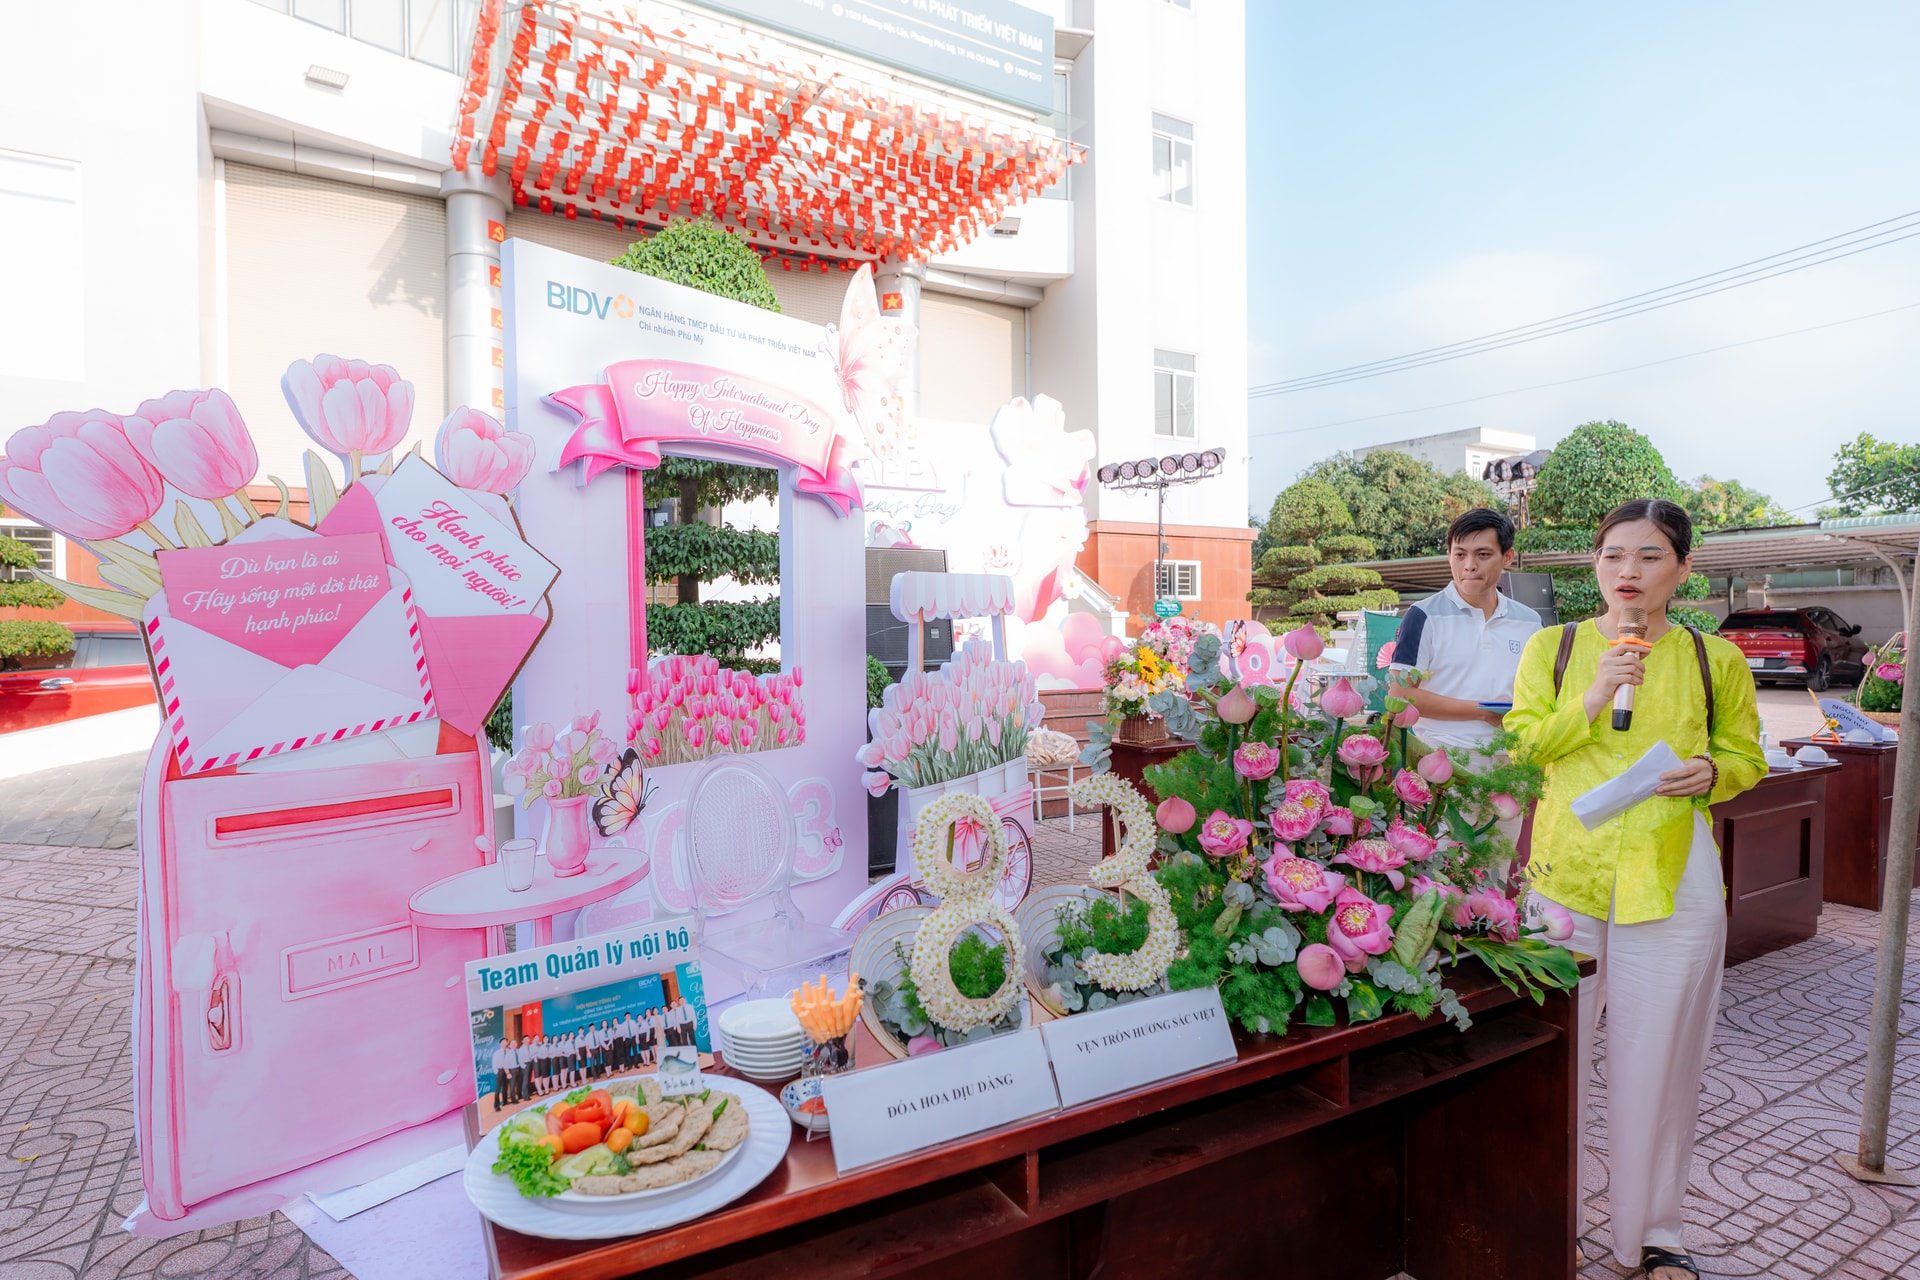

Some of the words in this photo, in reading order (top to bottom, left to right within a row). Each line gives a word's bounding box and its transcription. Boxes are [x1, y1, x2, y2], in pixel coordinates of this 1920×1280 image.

[960, 10, 993, 35] TRIỂN
[994, 22, 1018, 44] VIỆT
[1018, 32, 1043, 53] NAM
[547, 280, 613, 320] BIDV
[638, 305, 662, 320] NGÂN
[663, 310, 686, 326] HÀNG
[688, 318, 708, 331] TMCP
[709, 321, 725, 335] ĐẦU
[748, 333, 766, 346] PHÁT
[767, 337, 787, 351] TRIỂN
[788, 343, 802, 356] VIỆT
[802, 348, 817, 359] NAM
[638, 320, 652, 332] Chi
[653, 323, 676, 338] nhánh
[677, 329, 692, 341] Phú
[693, 334, 705, 345] Mỹ
[637, 372, 699, 401] Happy
[703, 378, 789, 415] International
[789, 404, 821, 434] Day
[689, 406, 711, 433] Of
[419, 500, 486, 550] Hạnh
[470, 550, 523, 582] phúc
[220, 557, 261, 580] Dù
[264, 554, 298, 575] bạn
[301, 551, 319, 569] là
[322, 551, 341, 566] ai
[391, 516, 428, 543] cho
[425, 543, 471, 571] mọi
[461, 570, 527, 611] người!
[183, 588, 237, 615] Hãy
[239, 585, 281, 609] sống
[284, 581, 317, 601] một
[347, 573, 380, 593] thật
[245, 611, 293, 635] hạnh
[292, 603, 343, 634] phúc!
[327, 944, 395, 974] MAIL
[478, 962, 540, 993] Team
[545, 945, 601, 979] Quản
[606, 939, 624, 966] lý
[630, 934, 662, 961] nội
[666, 926, 690, 953] bộ
[1076, 1039, 1100, 1054] VẸN
[1100, 1029, 1132, 1047] TRÒN
[1132, 1019, 1172, 1039] HƯƠNG
[1193, 1007, 1216, 1022] VIỆT
[920, 1092, 950, 1109] HOA
[952, 1083, 975, 1101] DỊU
[977, 1073, 1014, 1094] DÀNG
